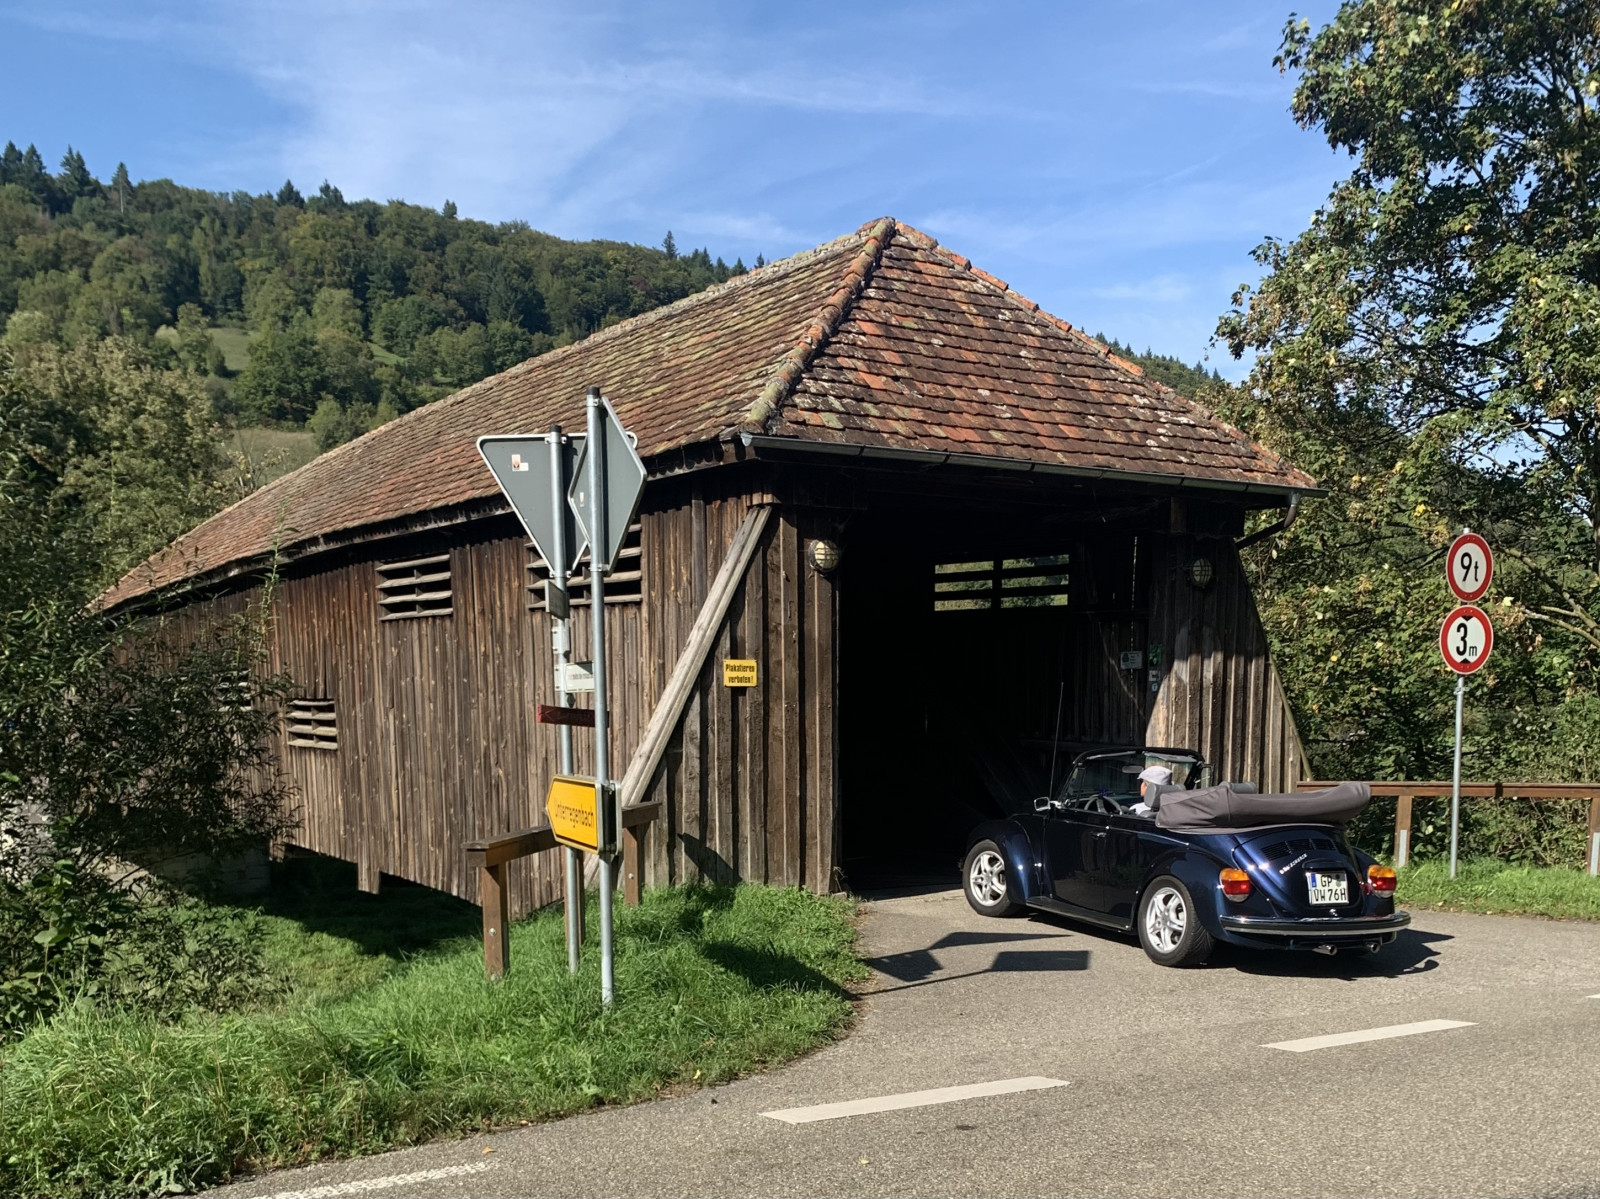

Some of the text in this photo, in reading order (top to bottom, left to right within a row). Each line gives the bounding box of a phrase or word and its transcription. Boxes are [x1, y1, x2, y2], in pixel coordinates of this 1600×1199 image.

[725, 663, 755, 673] Plakatieren
[728, 675, 754, 684] verboten!
[1320, 874, 1333, 887] GP
[1327, 888, 1347, 901] 76H
